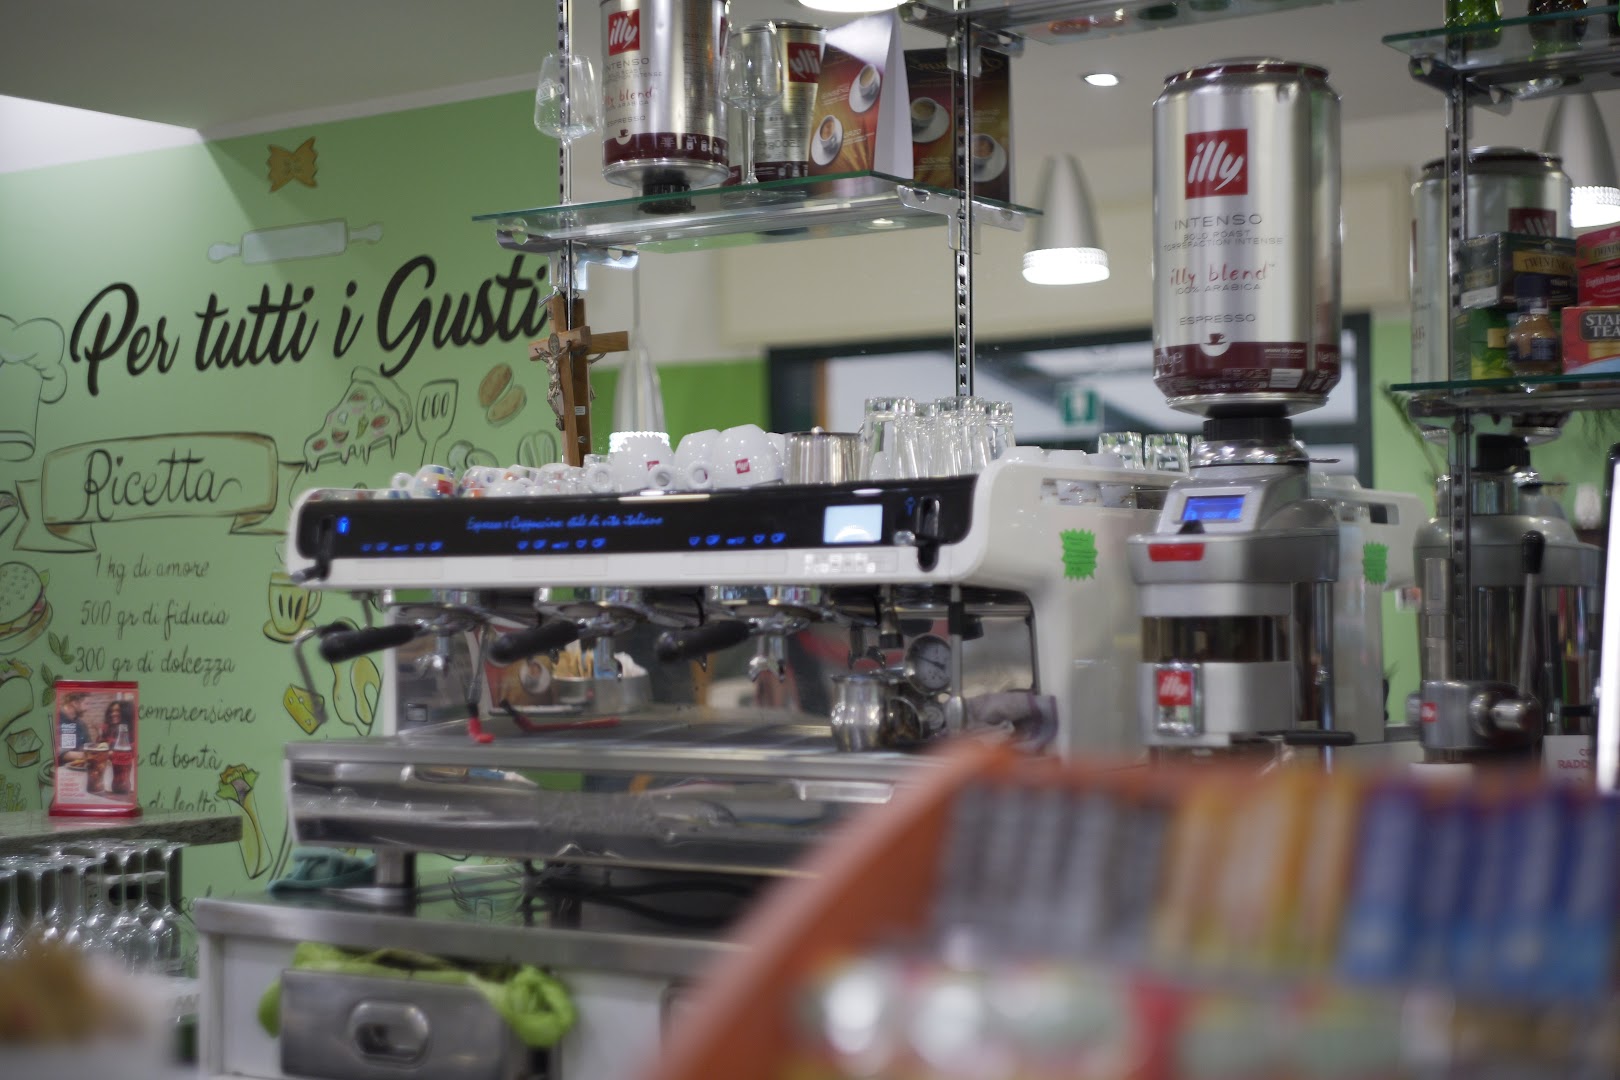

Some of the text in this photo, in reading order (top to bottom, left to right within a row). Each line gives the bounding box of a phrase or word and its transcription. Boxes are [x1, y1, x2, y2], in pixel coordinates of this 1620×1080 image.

[609, 17, 638, 49] illy
[606, 57, 650, 71] NTENSO
[1187, 139, 1245, 191] illy
[1173, 213, 1263, 230] INTENSO
[1212, 229, 1251, 239] ROAST
[1170, 266, 1196, 289] illy
[1204, 282, 1261, 293] ARABICA
[70, 253, 549, 397] Per tutti i Gusti
[1179, 313, 1256, 326] ESPRESSO
[1590, 325, 1620, 337] TEA
[76, 447, 243, 521] Ricetta
[96, 552, 102, 579] 1
[132, 552, 152, 579] di
[155, 560, 211, 579] amore
[81, 598, 231, 641] 500 gr di fiducia
[75, 643, 236, 688] 300 gr di dolcezza
[137, 698, 257, 737] comprensione
[149, 743, 223, 771] di bontà
[149, 790, 164, 809] di
